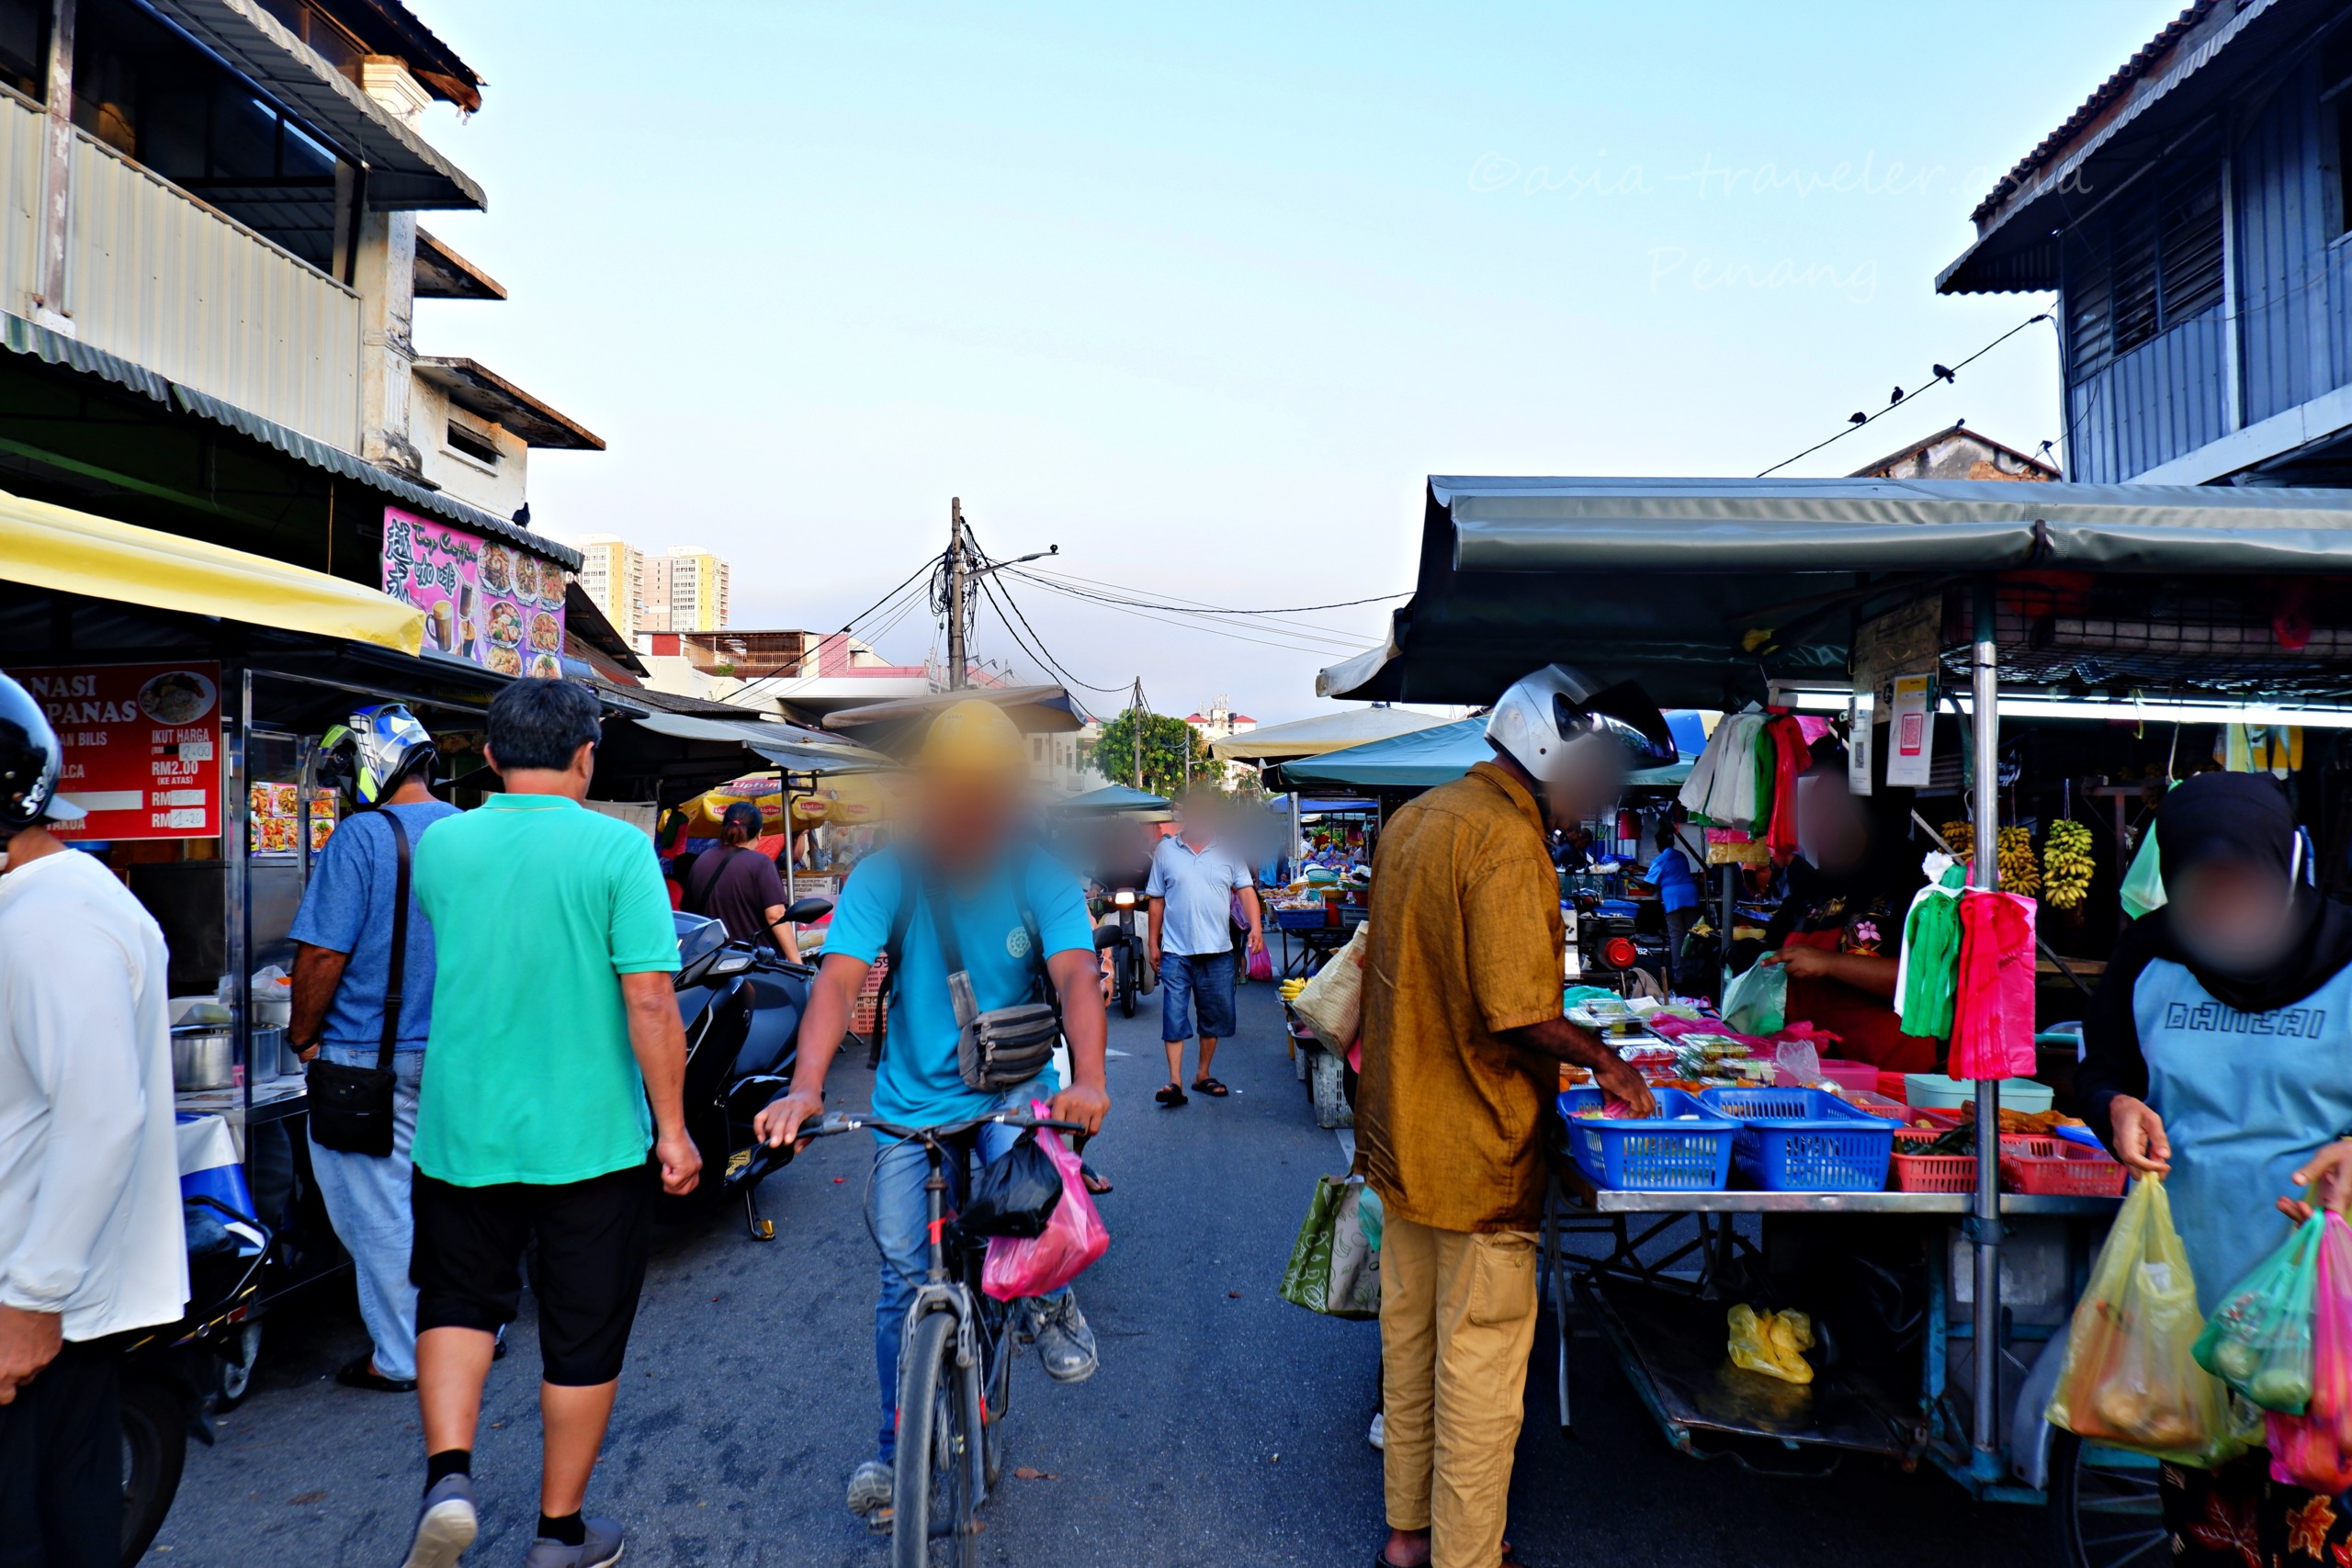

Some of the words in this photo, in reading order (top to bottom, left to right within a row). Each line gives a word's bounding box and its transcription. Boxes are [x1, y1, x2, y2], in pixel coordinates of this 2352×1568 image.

[412, 522, 438, 556] Top
[413, 553, 458, 597] 咖啡
[30, 675, 96, 698] NASI
[45, 701, 137, 724] PANAS
[78, 732, 107, 746] BILIS
[152, 730, 174, 743] IKUT
[176, 728, 209, 742] HARGA
[152, 761, 198, 775] RM2.00
[157, 777, 170, 785] (KE
[171, 776, 193, 784] ATAS)
[732, 780, 778, 790] Lipton
[152, 792, 171, 806] RM
[152, 814, 171, 828] RM
